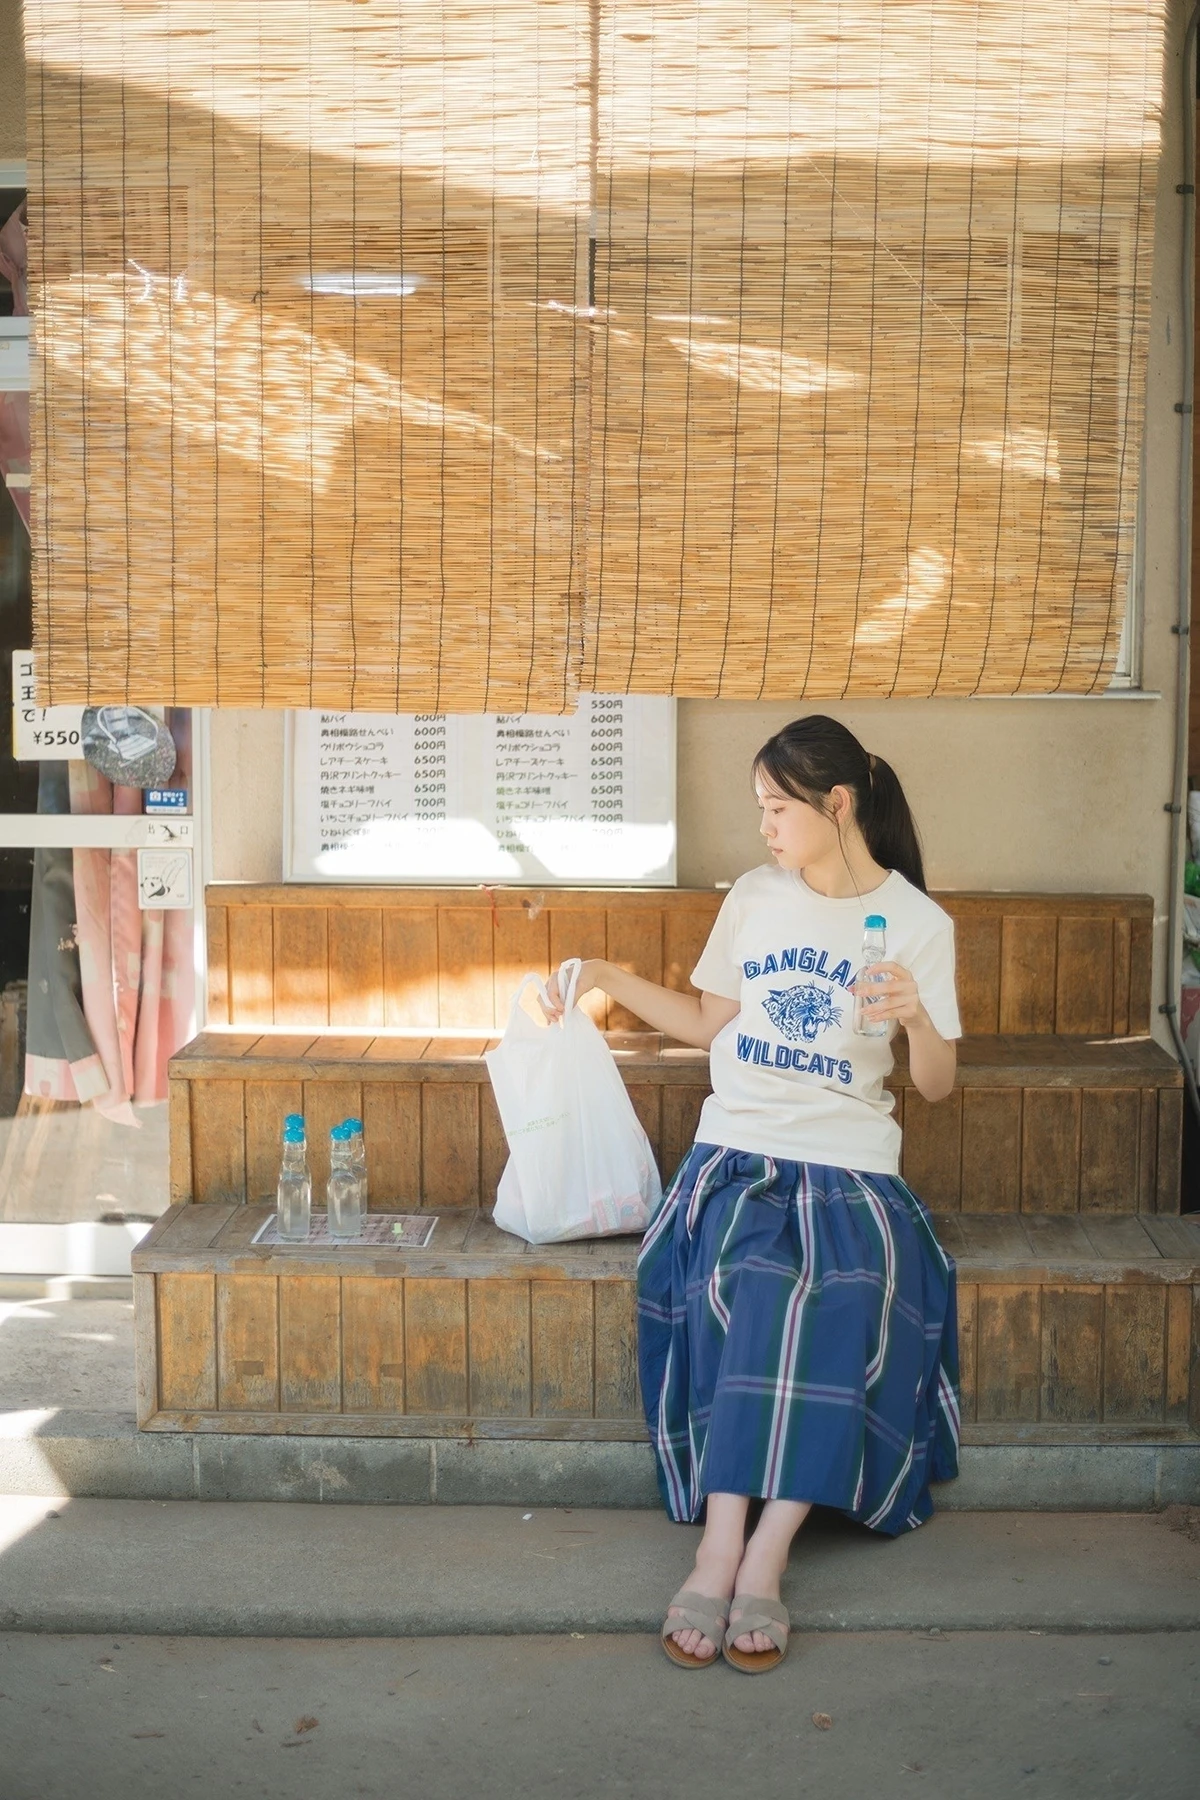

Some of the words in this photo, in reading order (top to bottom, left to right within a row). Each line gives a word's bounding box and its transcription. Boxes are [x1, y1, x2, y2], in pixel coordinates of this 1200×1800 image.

[590, 699, 623, 710] 550円
[590, 713, 623, 724] 600円
[414, 726, 446, 737] 600円
[590, 727, 623, 738] 600円
[33, 731, 80, 745] ¥550
[414, 740, 446, 751] 600円
[590, 741, 623, 752] 600円
[414, 754, 446, 765] 650円
[590, 756, 623, 767] 650円
[414, 769, 446, 780] 650円
[590, 770, 623, 781] 650円
[414, 783, 446, 794] 650円
[590, 785, 623, 796] 650円
[414, 797, 446, 808] 700円
[590, 799, 623, 810] 700円
[590, 813, 623, 824] 700円
[742, 947, 857, 990] GANGLA
[736, 1032, 853, 1084] WILDCATS
